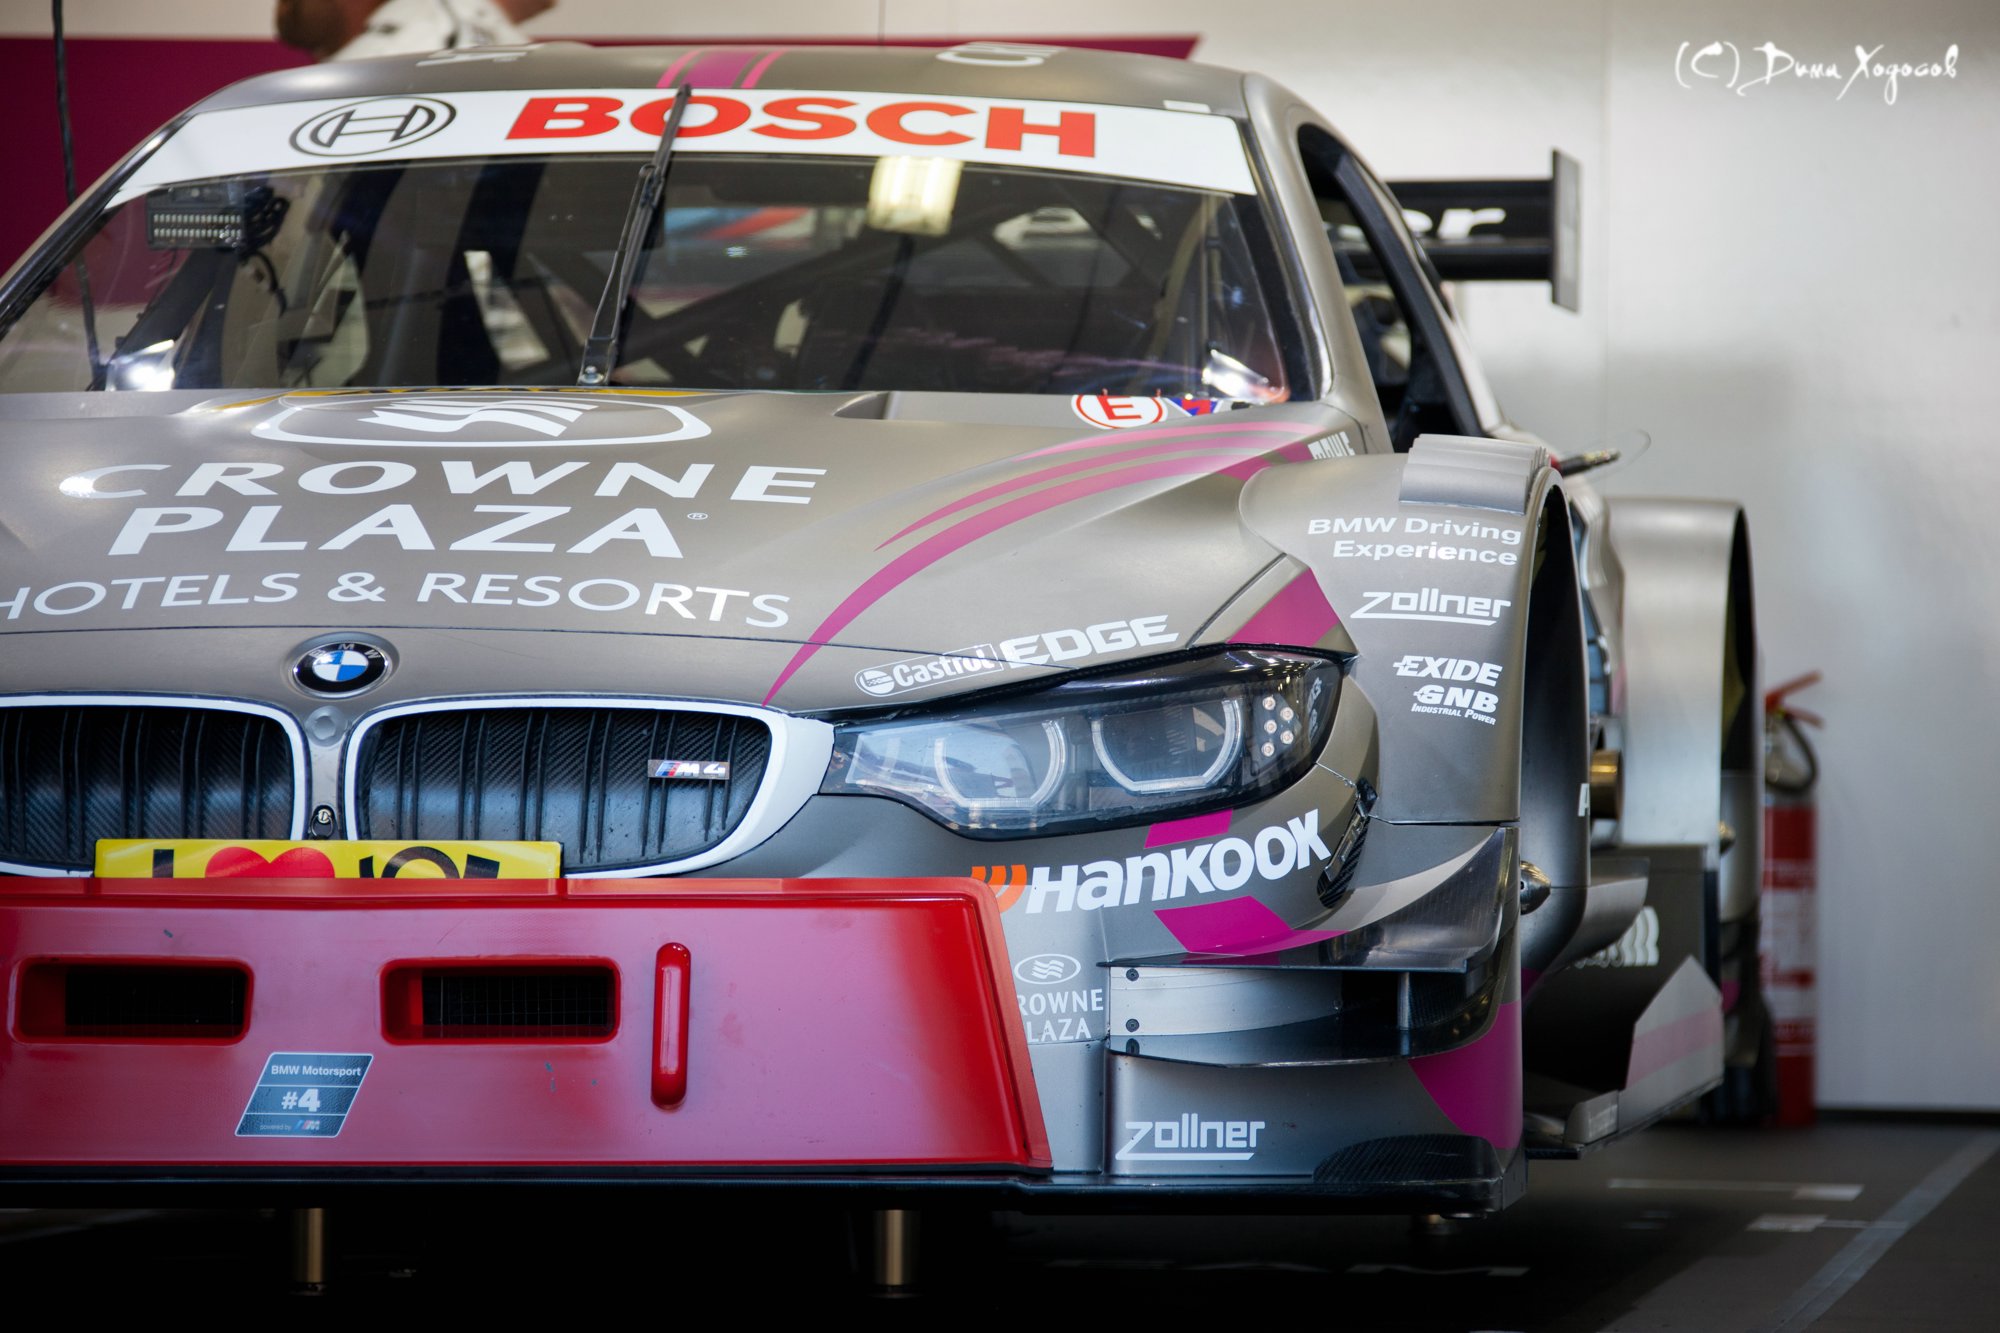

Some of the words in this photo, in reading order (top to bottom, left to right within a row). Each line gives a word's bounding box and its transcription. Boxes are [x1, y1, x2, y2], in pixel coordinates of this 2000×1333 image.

[505, 95, 1095, 158] BOSCH
[59, 460, 827, 504] CROWNE
[1307, 517, 1397, 535] BMW
[1404, 517, 1521, 545] Driving
[1333, 540, 1518, 565] Experience
[0, 573, 300, 620] HOTELS
[327, 572, 386, 602] &
[416, 572, 790, 628] RESORTS
[893, 649, 996, 687] Castrol
[1000, 614, 1180, 668] EDGE
[1393, 655, 1503, 687] EXIDE
[1413, 684, 1499, 713] GNB
[1017, 988, 1104, 1016] ROWNE
[1026, 1017, 1092, 1043] LAZA
[271, 1065, 299, 1075] BMW
[302, 1065, 361, 1077] Motorsport
[281, 1088, 321, 1112] #4
